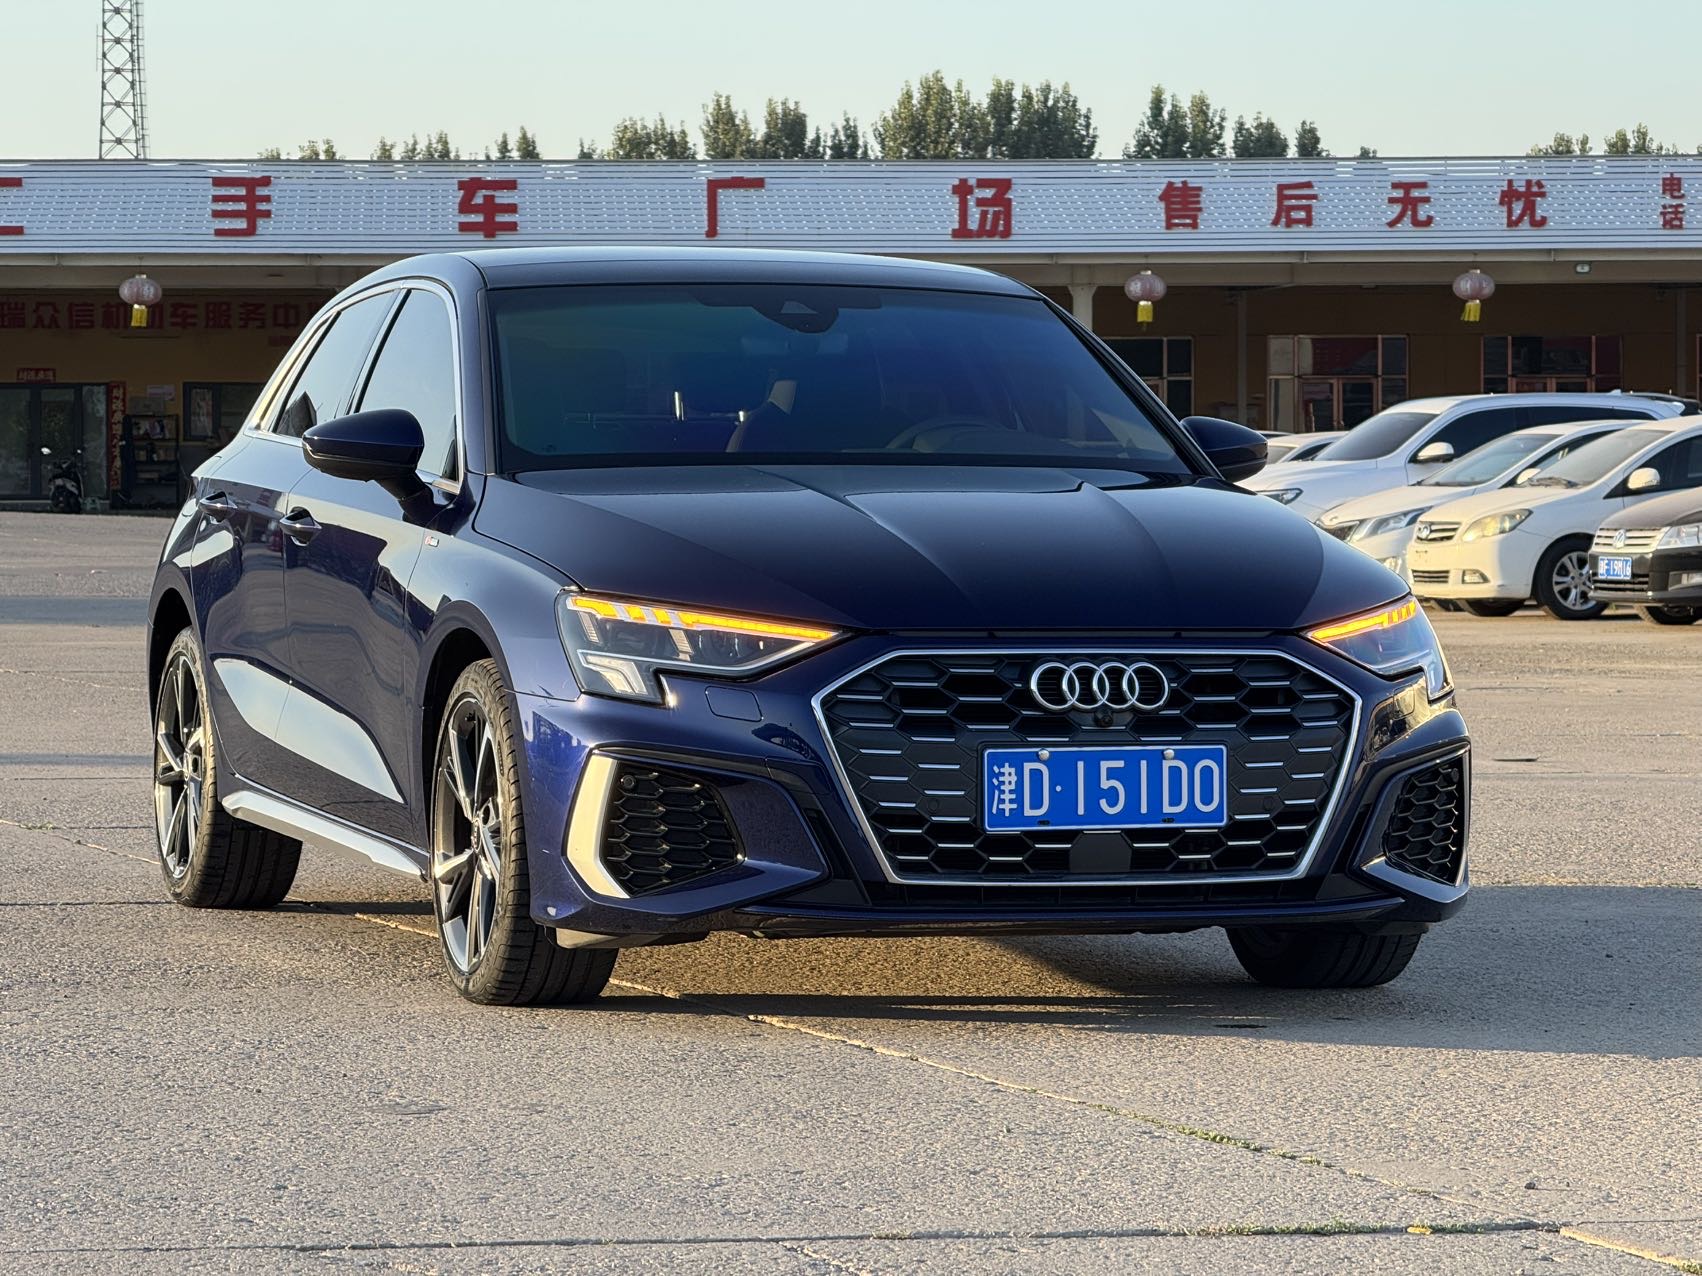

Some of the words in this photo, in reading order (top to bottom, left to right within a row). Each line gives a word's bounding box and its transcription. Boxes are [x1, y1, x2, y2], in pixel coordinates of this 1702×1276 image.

[1158, 179, 1547, 230] 售后无忧
[1660, 172, 1685, 230] 电话
[0, 302, 319, 330] 瑞众信机车服务中
